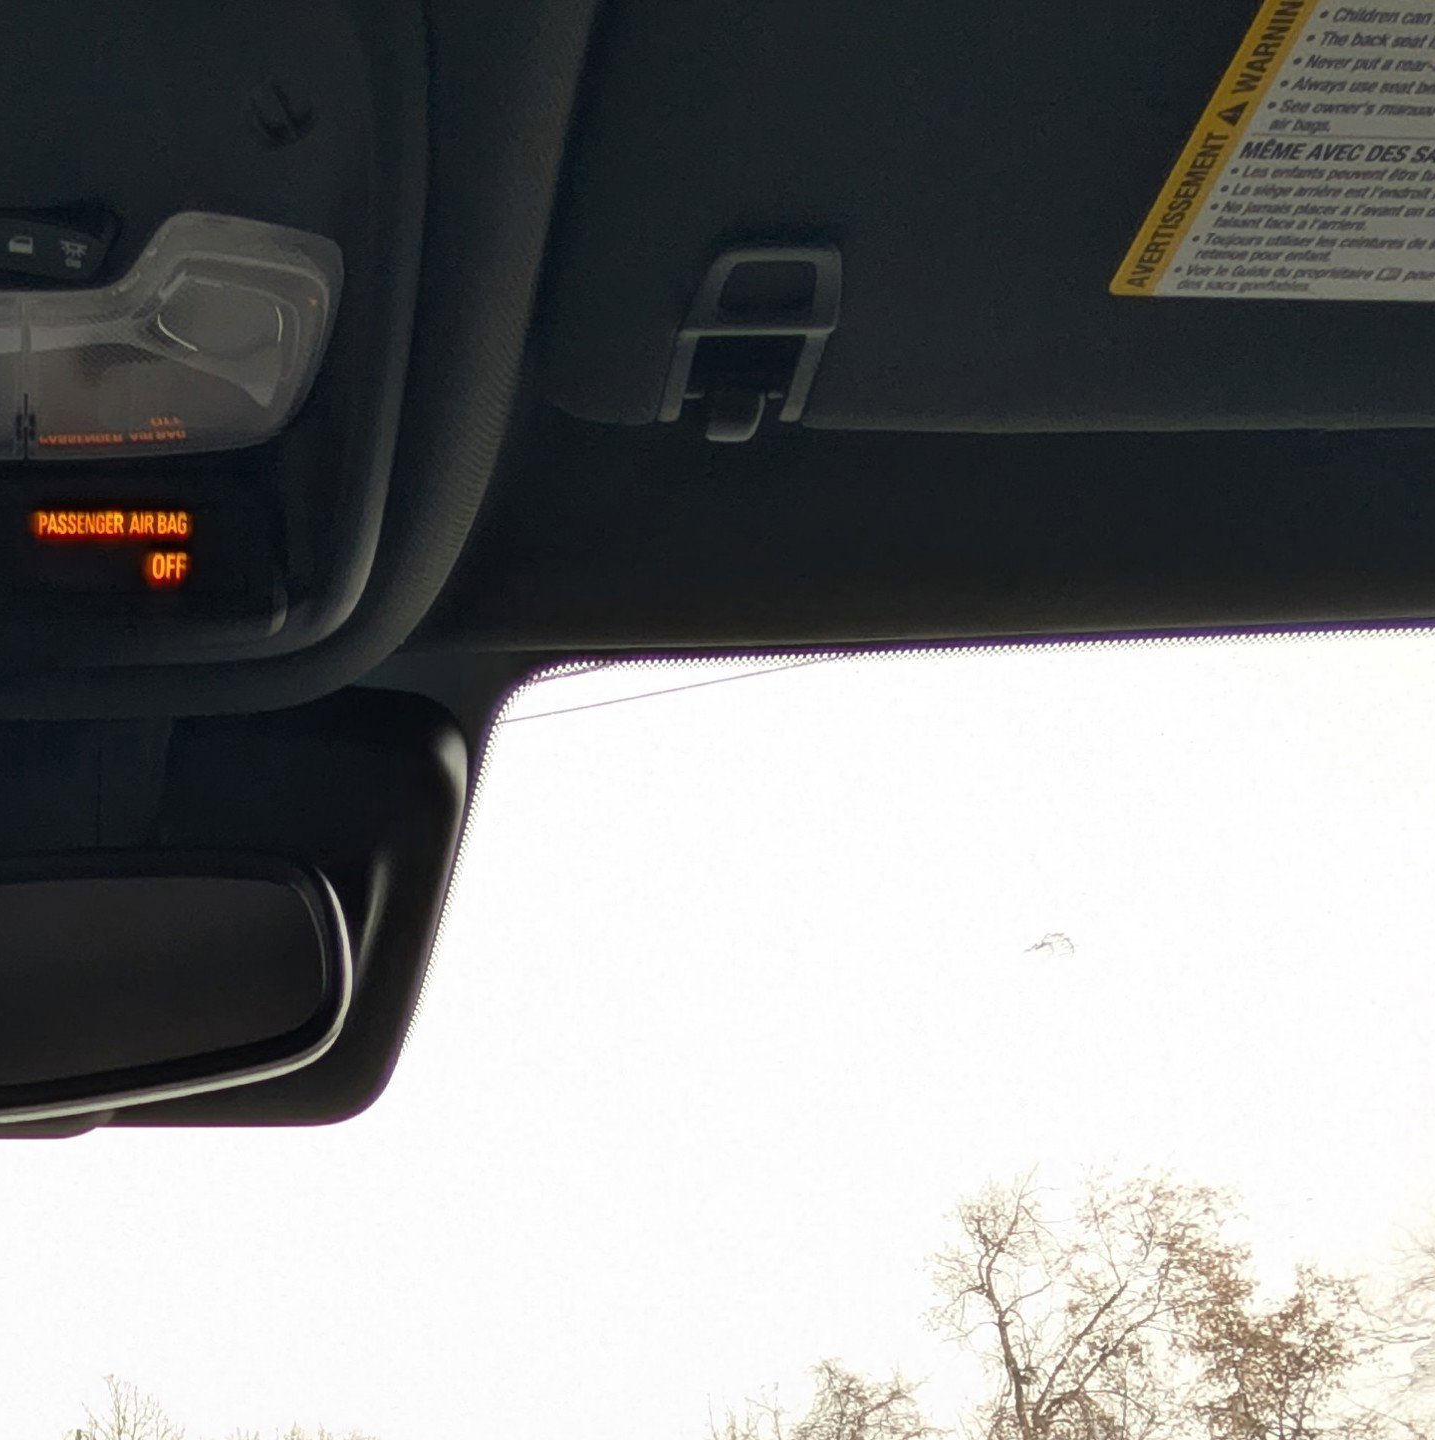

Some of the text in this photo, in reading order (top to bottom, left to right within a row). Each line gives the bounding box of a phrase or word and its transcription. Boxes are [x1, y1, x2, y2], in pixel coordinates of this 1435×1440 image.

[1333, 7, 1399, 24] Children
[1402, 12, 1432, 25] can
[1232, 0, 1305, 96] WARNIN
[1321, 31, 1349, 46] The
[1351, 33, 1388, 47] back
[1391, 35, 1427, 48] seat
[1306, 54, 1353, 69] Never
[1352, 57, 1381, 72] put
[1381, 60, 1393, 70] a
[1291, 77, 1348, 94] Always
[1348, 82, 1378, 93] use
[1379, 81, 1416, 95] seat
[1279, 99, 1311, 114] See
[1311, 101, 1376, 115] owner's
[1239, 138, 1308, 159] MÊME
[1305, 144, 1364, 162] AVEC
[1365, 145, 1412, 163] DES
[1126, 132, 1230, 288] AVERTISSEMENT
[38, 512, 189, 535] PASSENGER AIR BAG
[152, 552, 187, 580] OFF
